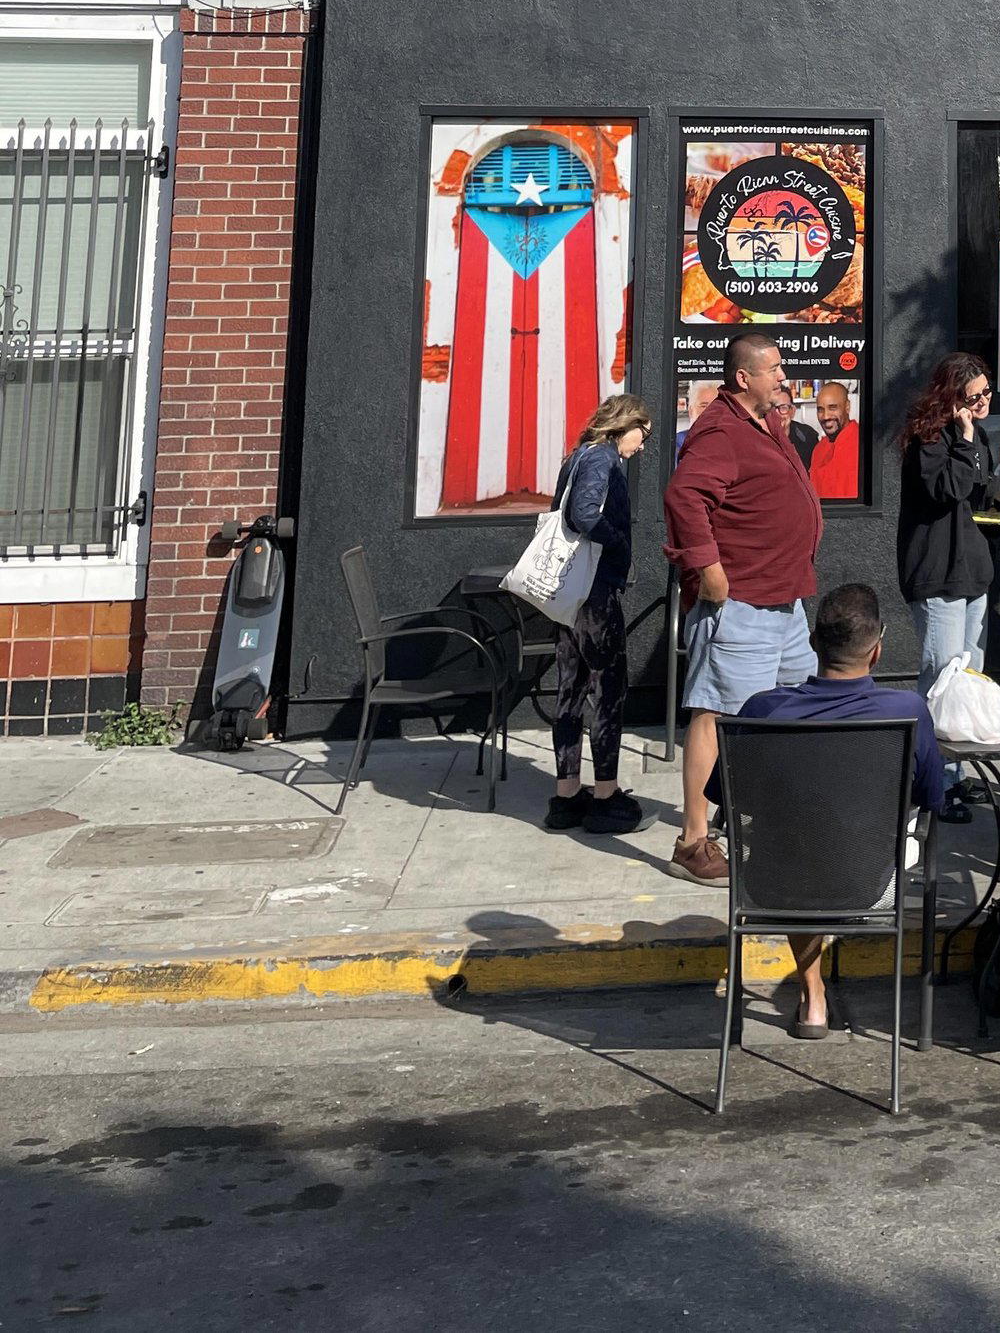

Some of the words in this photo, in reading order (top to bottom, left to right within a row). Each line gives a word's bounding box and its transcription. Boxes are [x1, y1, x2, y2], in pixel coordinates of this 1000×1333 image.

[682, 124, 870, 137] www.puertoricanstreetcuisine.com
[706, 193, 738, 240] Puerto
[736, 175, 780, 197] Rican
[781, 170, 829, 199] Street
[818, 197, 842, 242] Cuisine
[725, 280, 755, 296] (510)
[757, 281, 819, 294] 603-2906
[672, 335, 704, 349] Take
[706, 337, 729, 349] out
[811, 335, 866, 352] Delivery
